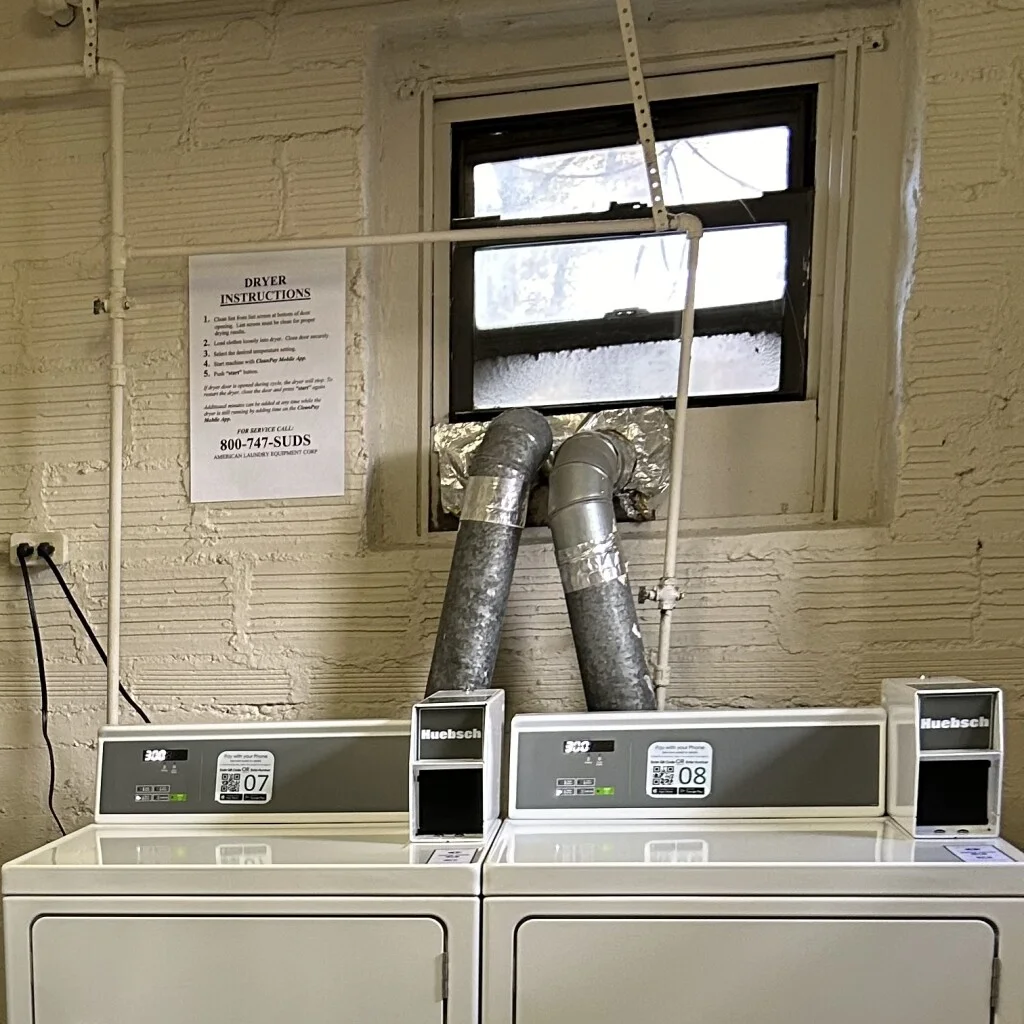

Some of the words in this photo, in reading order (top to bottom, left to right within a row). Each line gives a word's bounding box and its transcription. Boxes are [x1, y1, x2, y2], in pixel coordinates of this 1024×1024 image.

[244, 275, 287, 288] DRYER
[220, 288, 312, 304] INSTRUCTIONS
[204, 315, 210, 323] 1.
[204, 370, 210, 378] 5.
[220, 434, 311, 451] 800-747-SUDS
[244, 450, 270, 458] LAUNDRY
[920, 716, 990, 730] Huebsch
[421, 728, 482, 740] Huebsch
[678, 766, 706, 785] 08
[244, 774, 269, 792] 07
